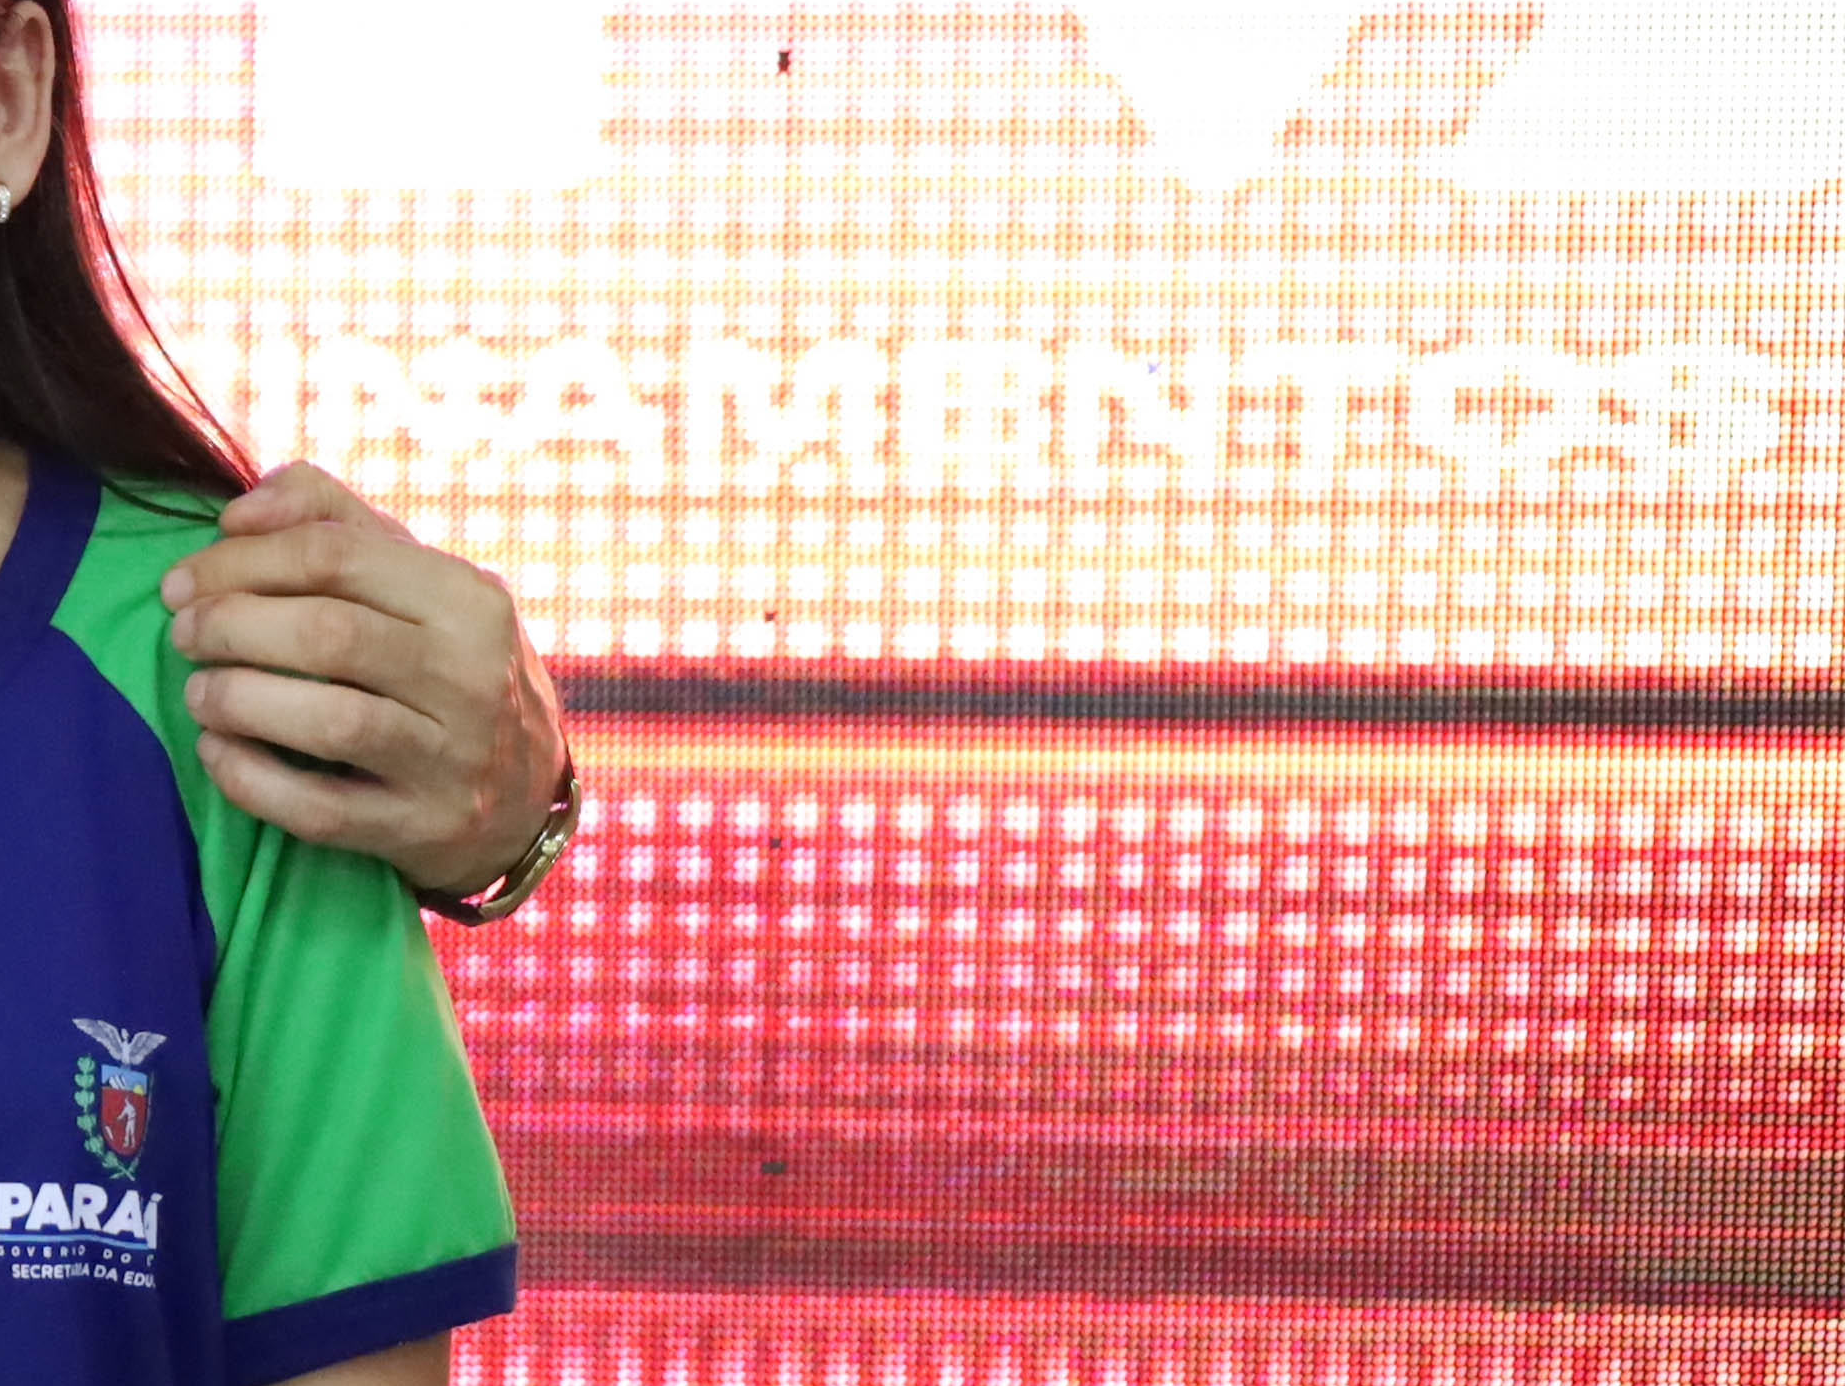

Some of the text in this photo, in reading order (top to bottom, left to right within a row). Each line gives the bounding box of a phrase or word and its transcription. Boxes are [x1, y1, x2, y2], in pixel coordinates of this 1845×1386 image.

[103, 1248, 132, 1264] DO
[94, 1264, 119, 1282] DA
[123, 1271, 157, 1289] EDU
